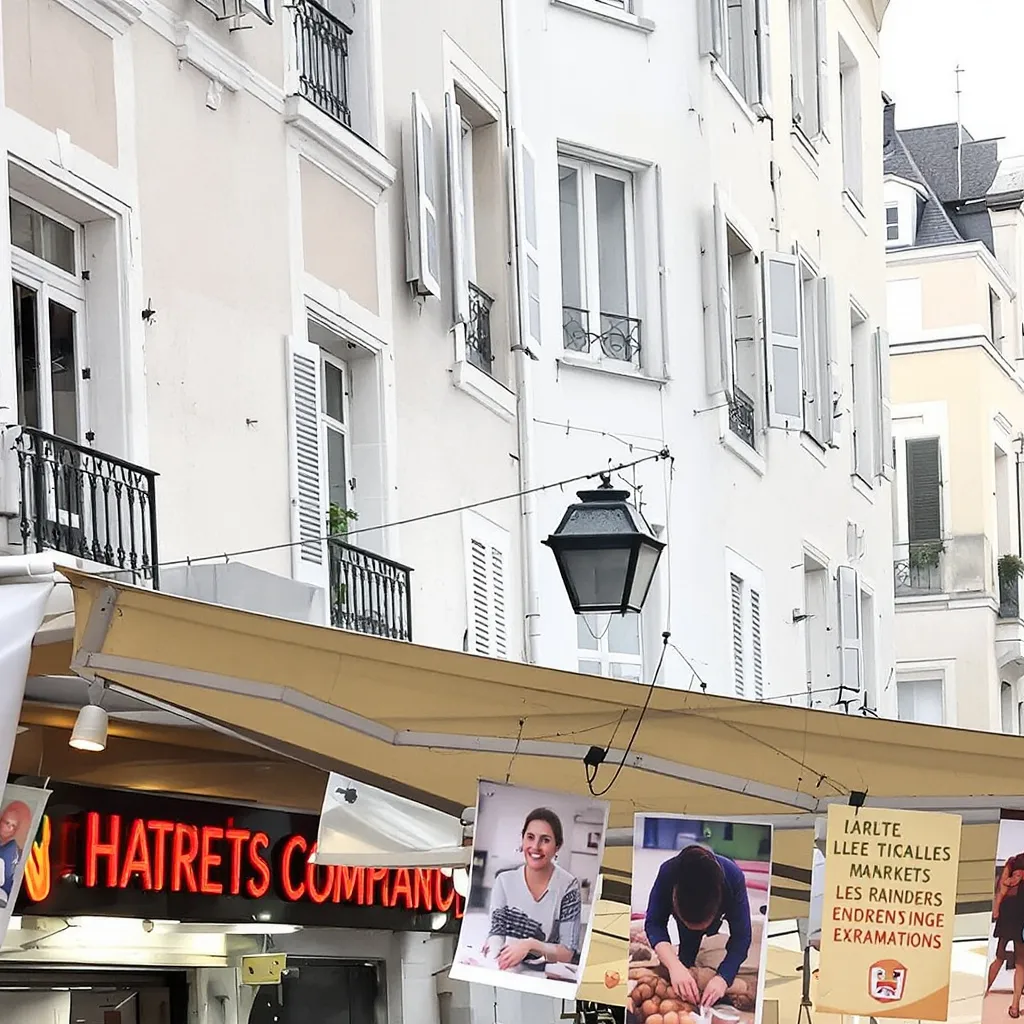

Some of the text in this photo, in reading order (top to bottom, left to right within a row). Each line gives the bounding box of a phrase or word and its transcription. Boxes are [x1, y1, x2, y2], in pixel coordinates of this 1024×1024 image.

[85, 810, 271, 900] HATRETS
[833, 840, 869, 856] LLEE
[836, 884, 943, 907] LES RAINDERS
[833, 927, 942, 950] EXRAMATIONS
